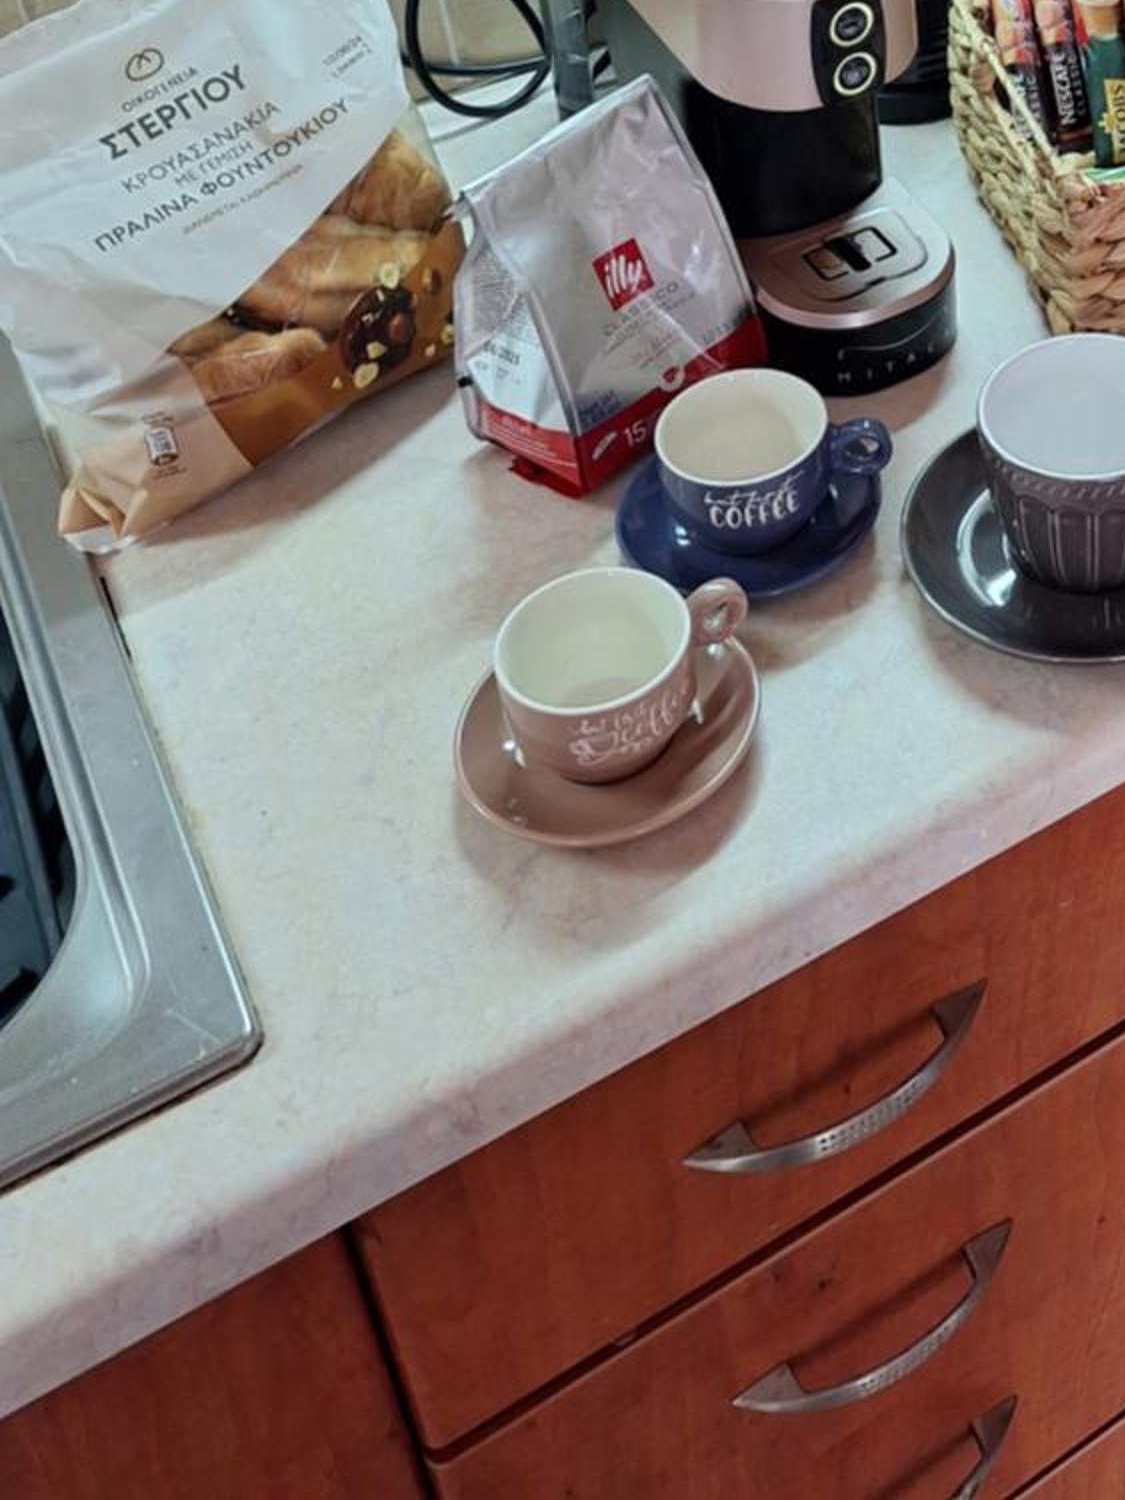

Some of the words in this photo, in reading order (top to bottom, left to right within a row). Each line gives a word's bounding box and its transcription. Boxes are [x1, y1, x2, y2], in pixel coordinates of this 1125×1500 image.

[99, 64, 247, 160] ΣΤΕΡΓΙΟΥ
[121, 66, 199, 113] ΟΙΚΟΓΕΝΕΙΑ
[120, 101, 281, 193] ΚΡΟΥΑΣΑΝΑΚΙΑ
[95, 192, 200, 252] ΠΡΑΛΙΝΑ
[199, 97, 350, 196] ΦΟΥΝΤΟΥΚΙΟΥ
[174, 171, 199, 189] ΜΕ
[605, 254, 642, 299] illy
[623, 420, 647, 446] 15
[709, 490, 800, 530] COFFEE
